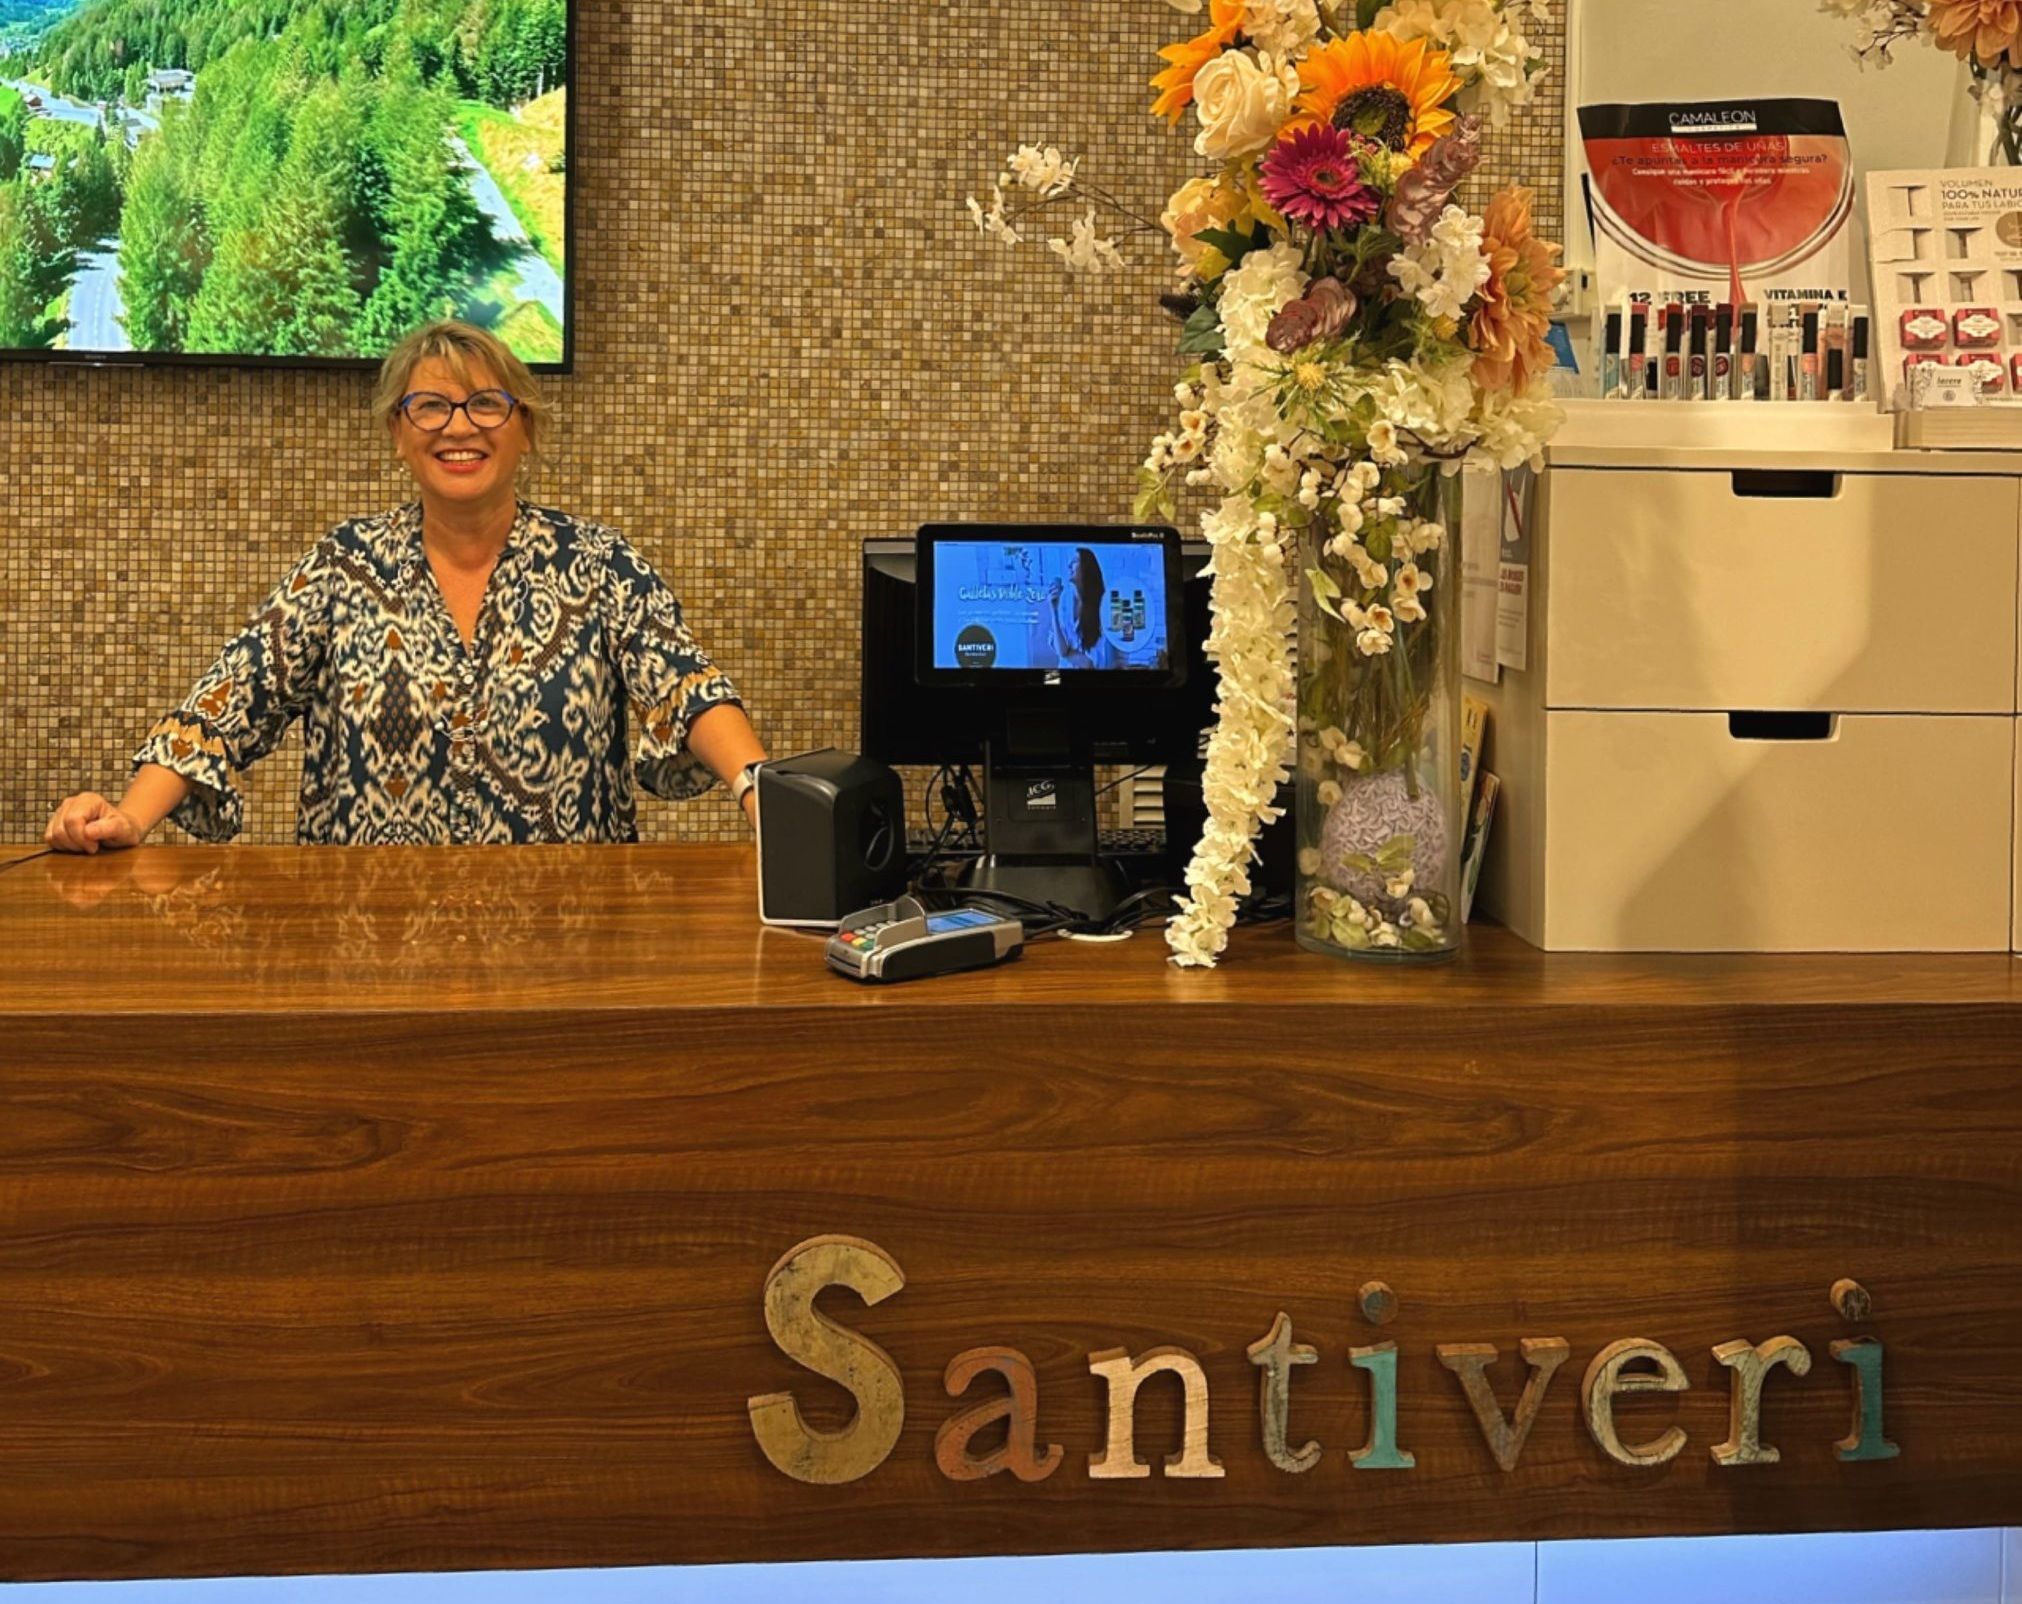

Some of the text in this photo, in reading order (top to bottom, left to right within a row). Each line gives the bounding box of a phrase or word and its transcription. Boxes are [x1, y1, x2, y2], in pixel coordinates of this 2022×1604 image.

[1668, 109, 1756, 126] CAMALEON
[1651, 137, 1784, 154] ESMALTES DE UÑAS
[1612, 156, 1635, 166] ¿Te
[1638, 156, 1687, 168] apuntas
[1690, 157, 1699, 165] a
[1702, 155, 1713, 165] la
[1779, 154, 1828, 166] segura?
[1940, 180, 1993, 188] VOLUMEN
[1941, 188, 1980, 200] 100%
[1942, 201, 1969, 210] PARA
[1972, 200, 1992, 209] TUS
[1629, 290, 1712, 305] 12 FREE
[1763, 288, 1835, 300] VITAMINA
[958, 643, 994, 653] SANTIVERI
[748, 1233, 1901, 1486] Santiveri
